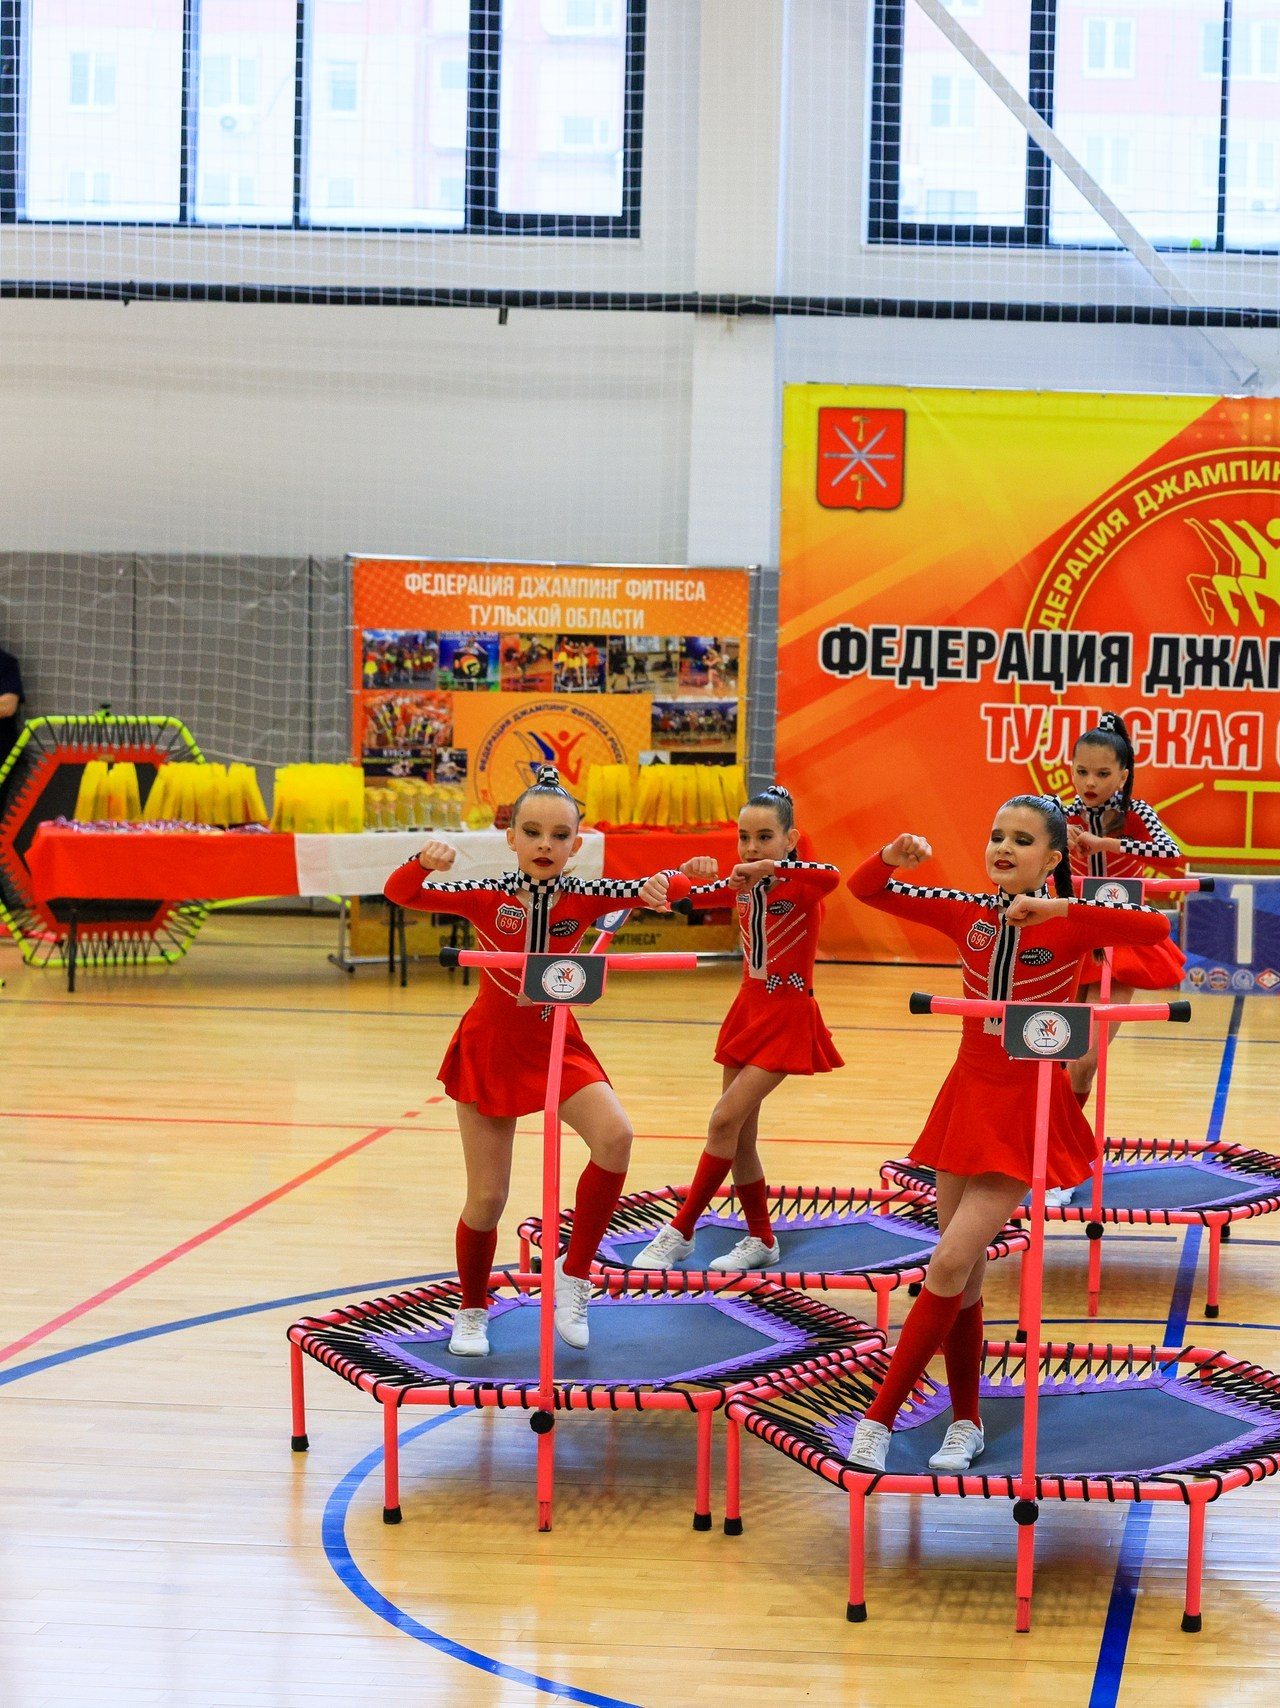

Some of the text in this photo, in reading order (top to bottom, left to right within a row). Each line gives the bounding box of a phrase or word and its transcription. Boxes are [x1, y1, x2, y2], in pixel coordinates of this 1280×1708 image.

[404, 573, 706, 601] ФЕДЕРАЦИЯ ДЖАМПИНГ ФИТНЕСА
[1038, 508, 1130, 633] ДЕРАЦИЯ
[469, 603, 645, 629] ТУЛЬСКОЙ ОБЛАСТИ
[820, 625, 1132, 692] ФЕДЕРАЦИЯ
[981, 703, 1264, 771] ТУЛСКАЯ
[500, 916, 519, 930] 696
[970, 932, 988, 947] 696
[1229, 883, 1254, 965] 1
